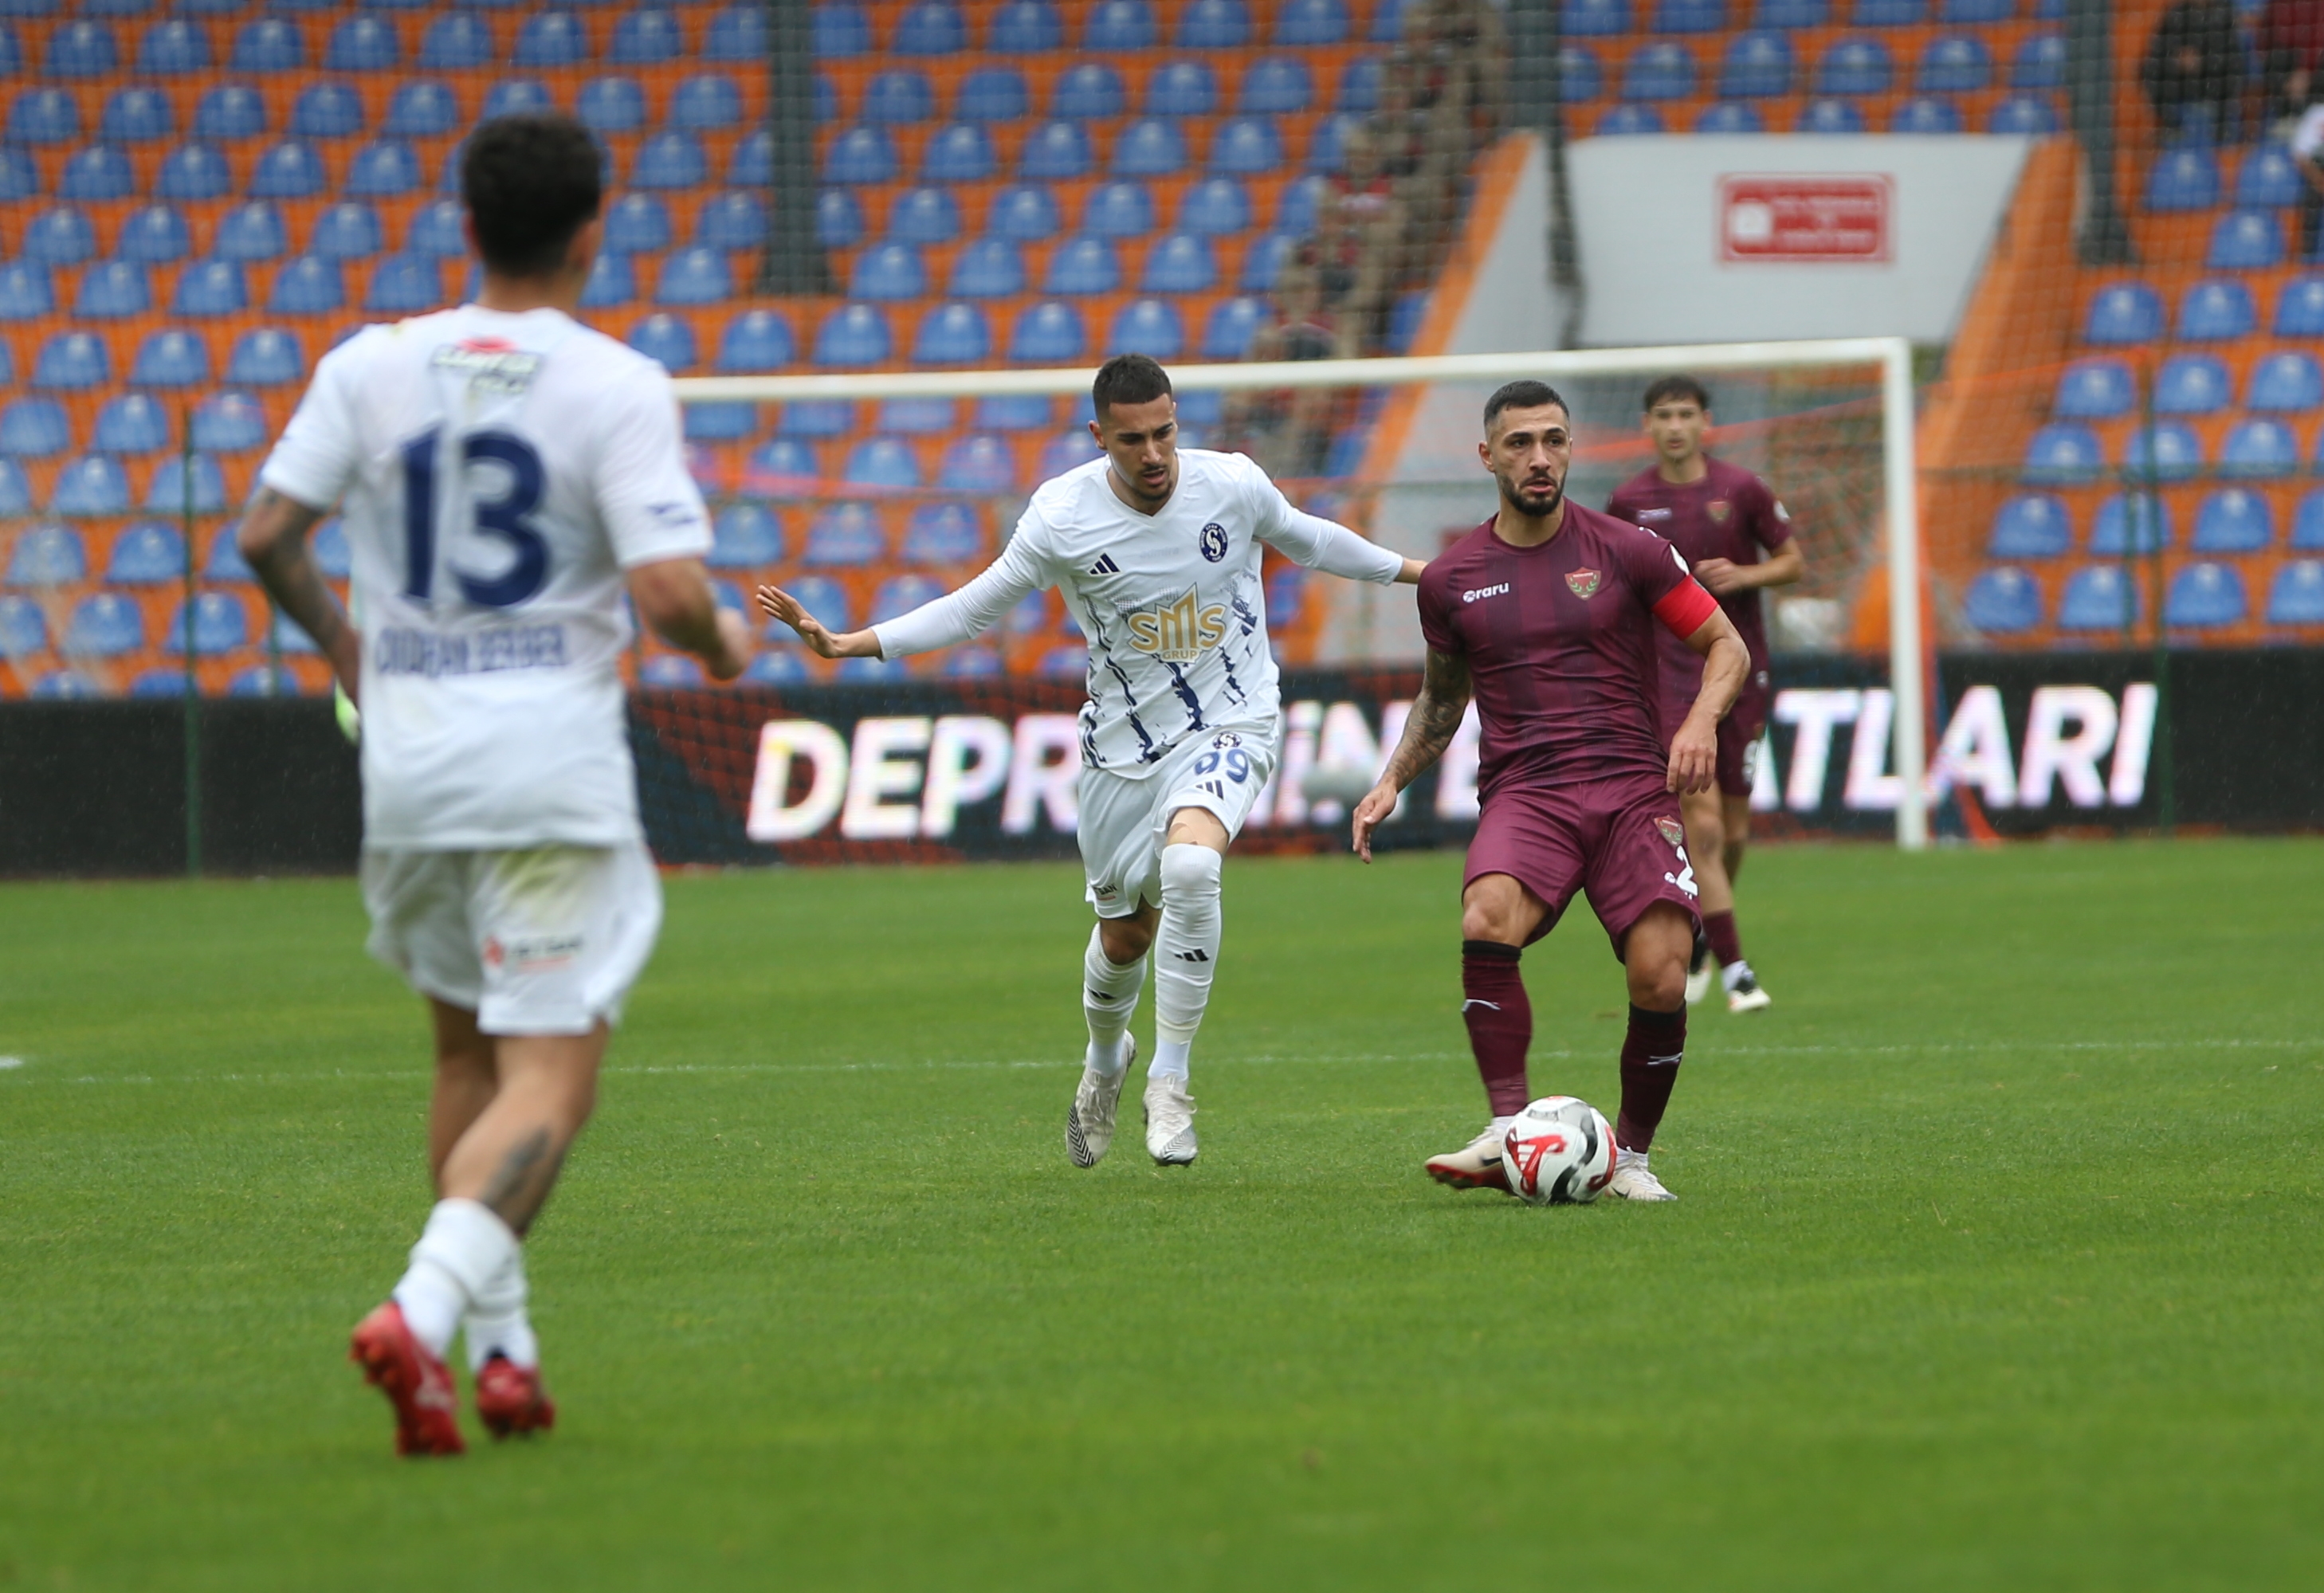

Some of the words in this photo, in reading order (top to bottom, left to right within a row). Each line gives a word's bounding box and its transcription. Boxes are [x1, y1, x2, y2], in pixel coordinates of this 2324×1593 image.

[398, 422, 552, 609] 13
[1129, 591, 1226, 652] SMS
[1162, 650, 1198, 660] GRUP
[1194, 749, 1249, 783] 99
